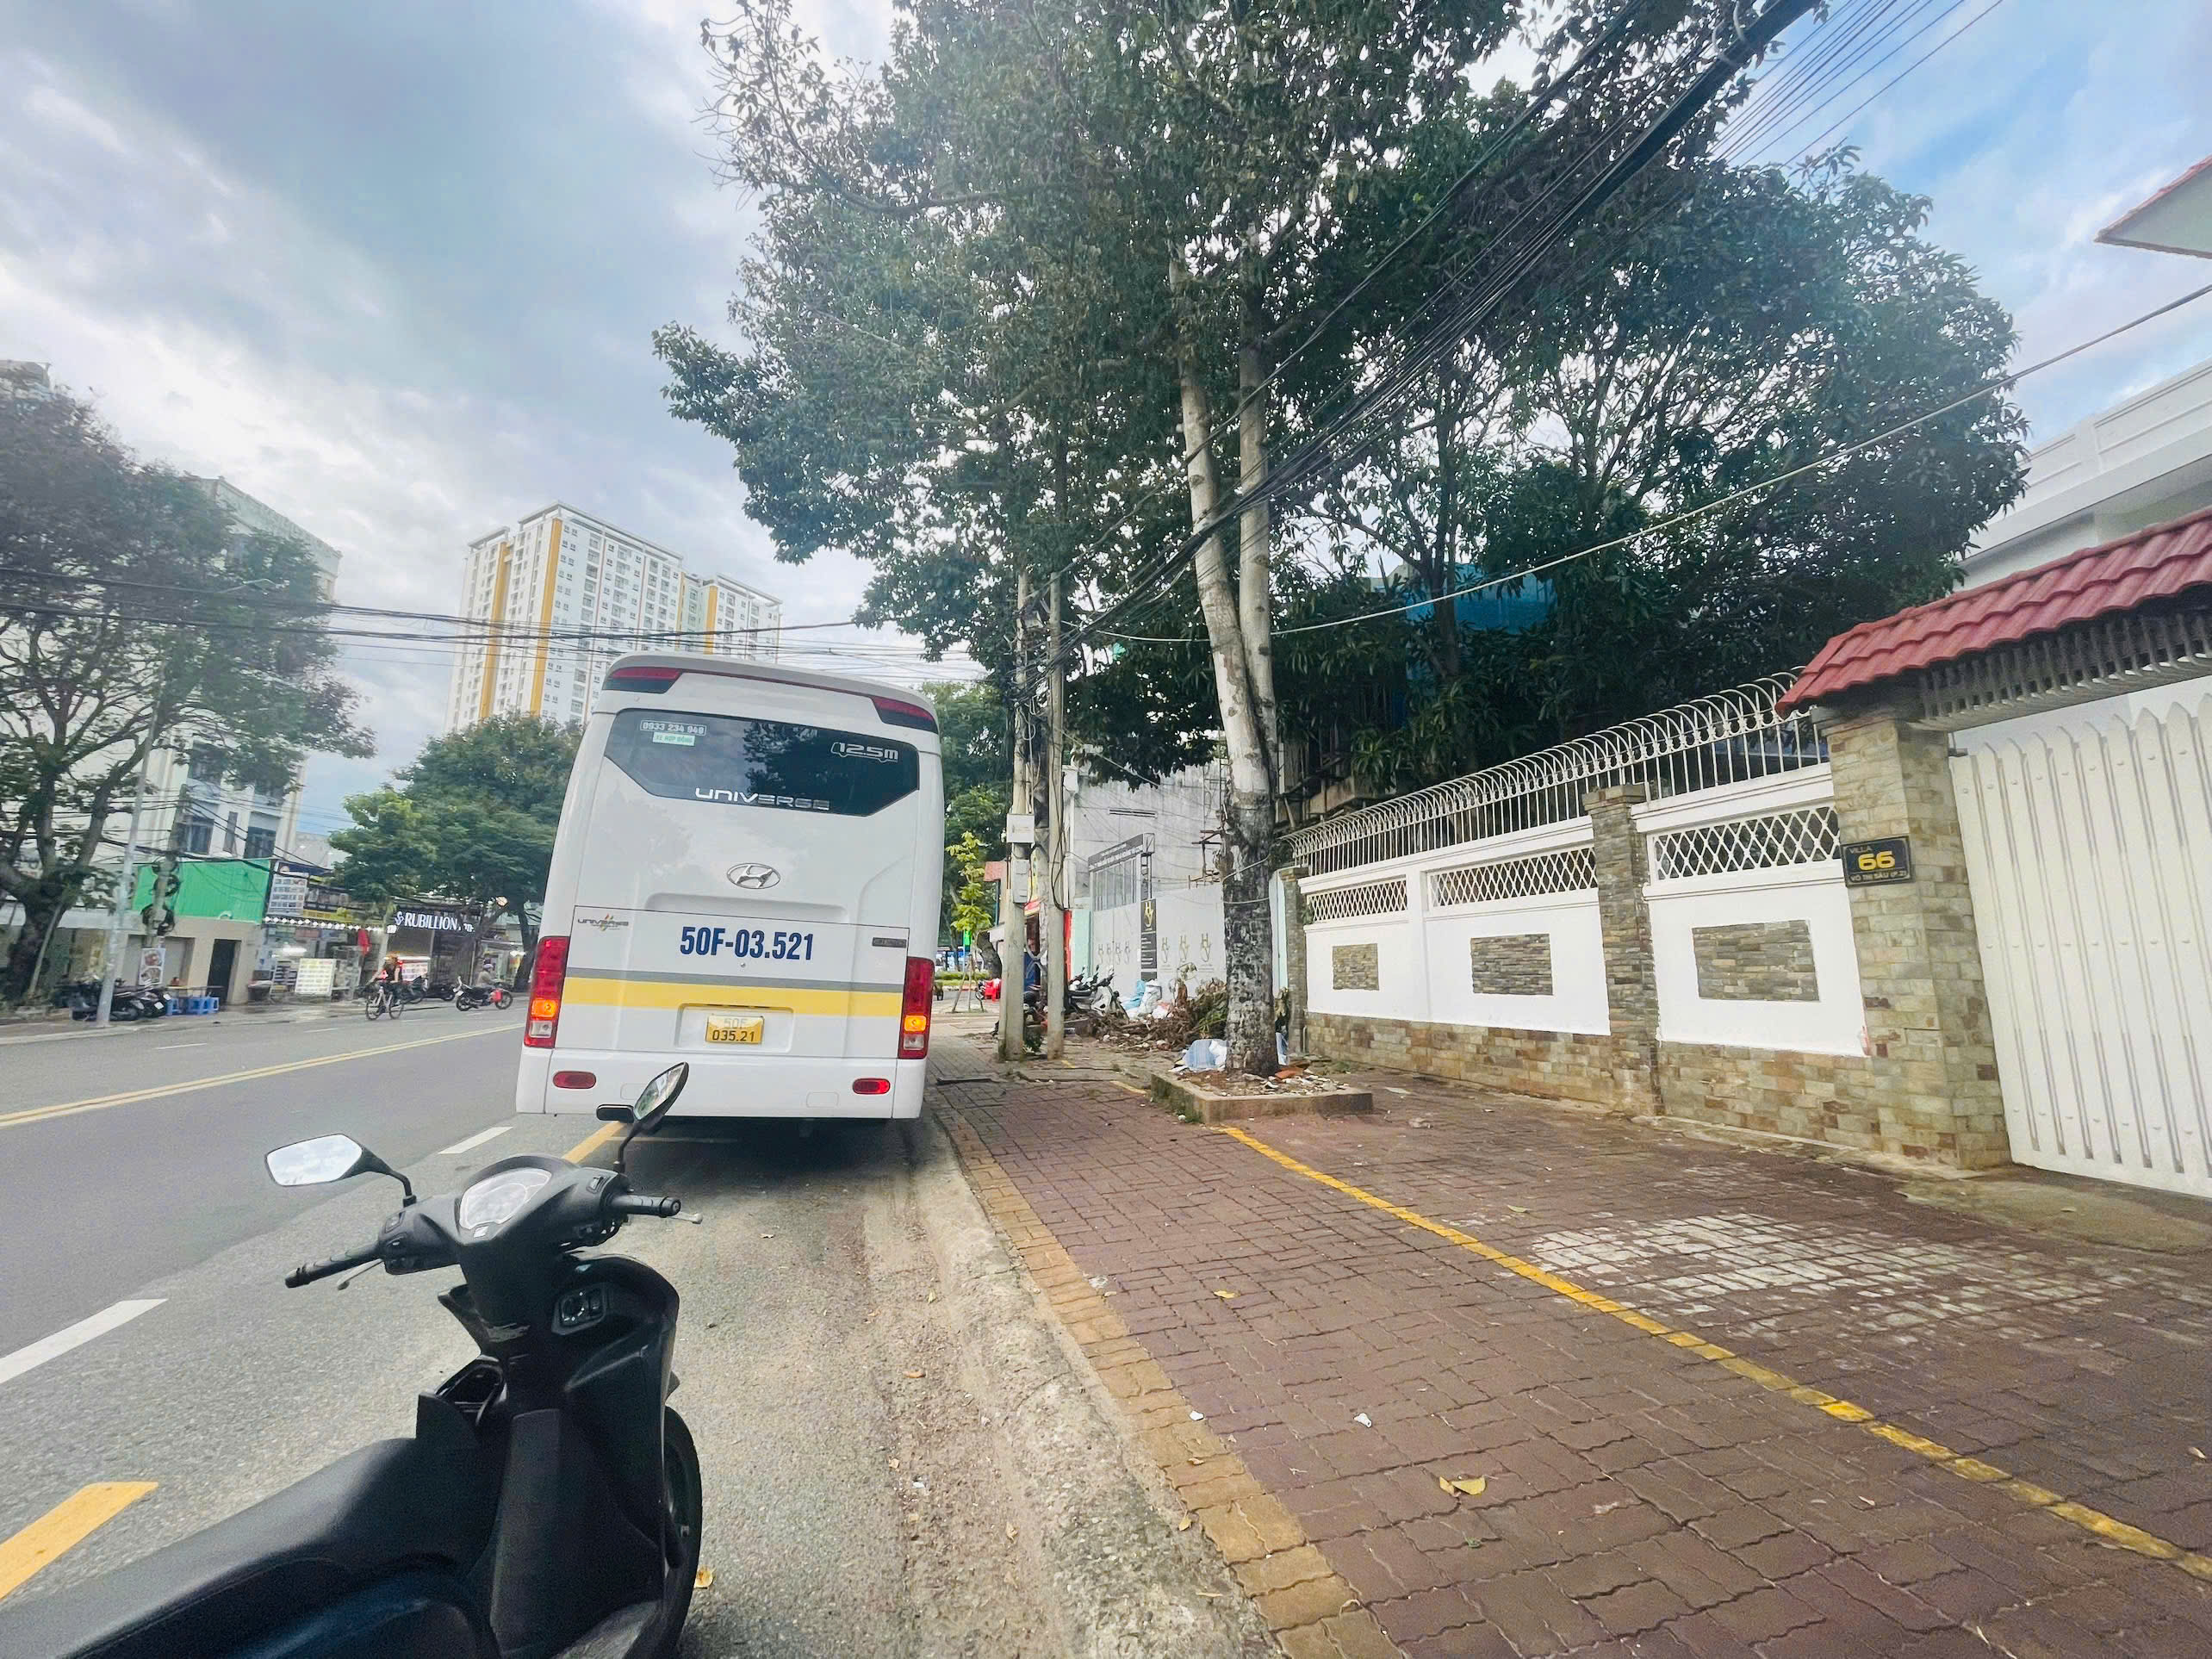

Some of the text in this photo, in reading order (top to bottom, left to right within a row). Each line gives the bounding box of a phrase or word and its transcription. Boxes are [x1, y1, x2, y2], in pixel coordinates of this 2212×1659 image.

[642, 722, 665, 730] 0933
[667, 724, 685, 732] 234
[695, 787, 830, 811] UNIVERSE
[1858, 850, 1896, 871] 66
[680, 926, 814, 960] 50F-03.521
[711, 1029, 755, 1042] 035.21
